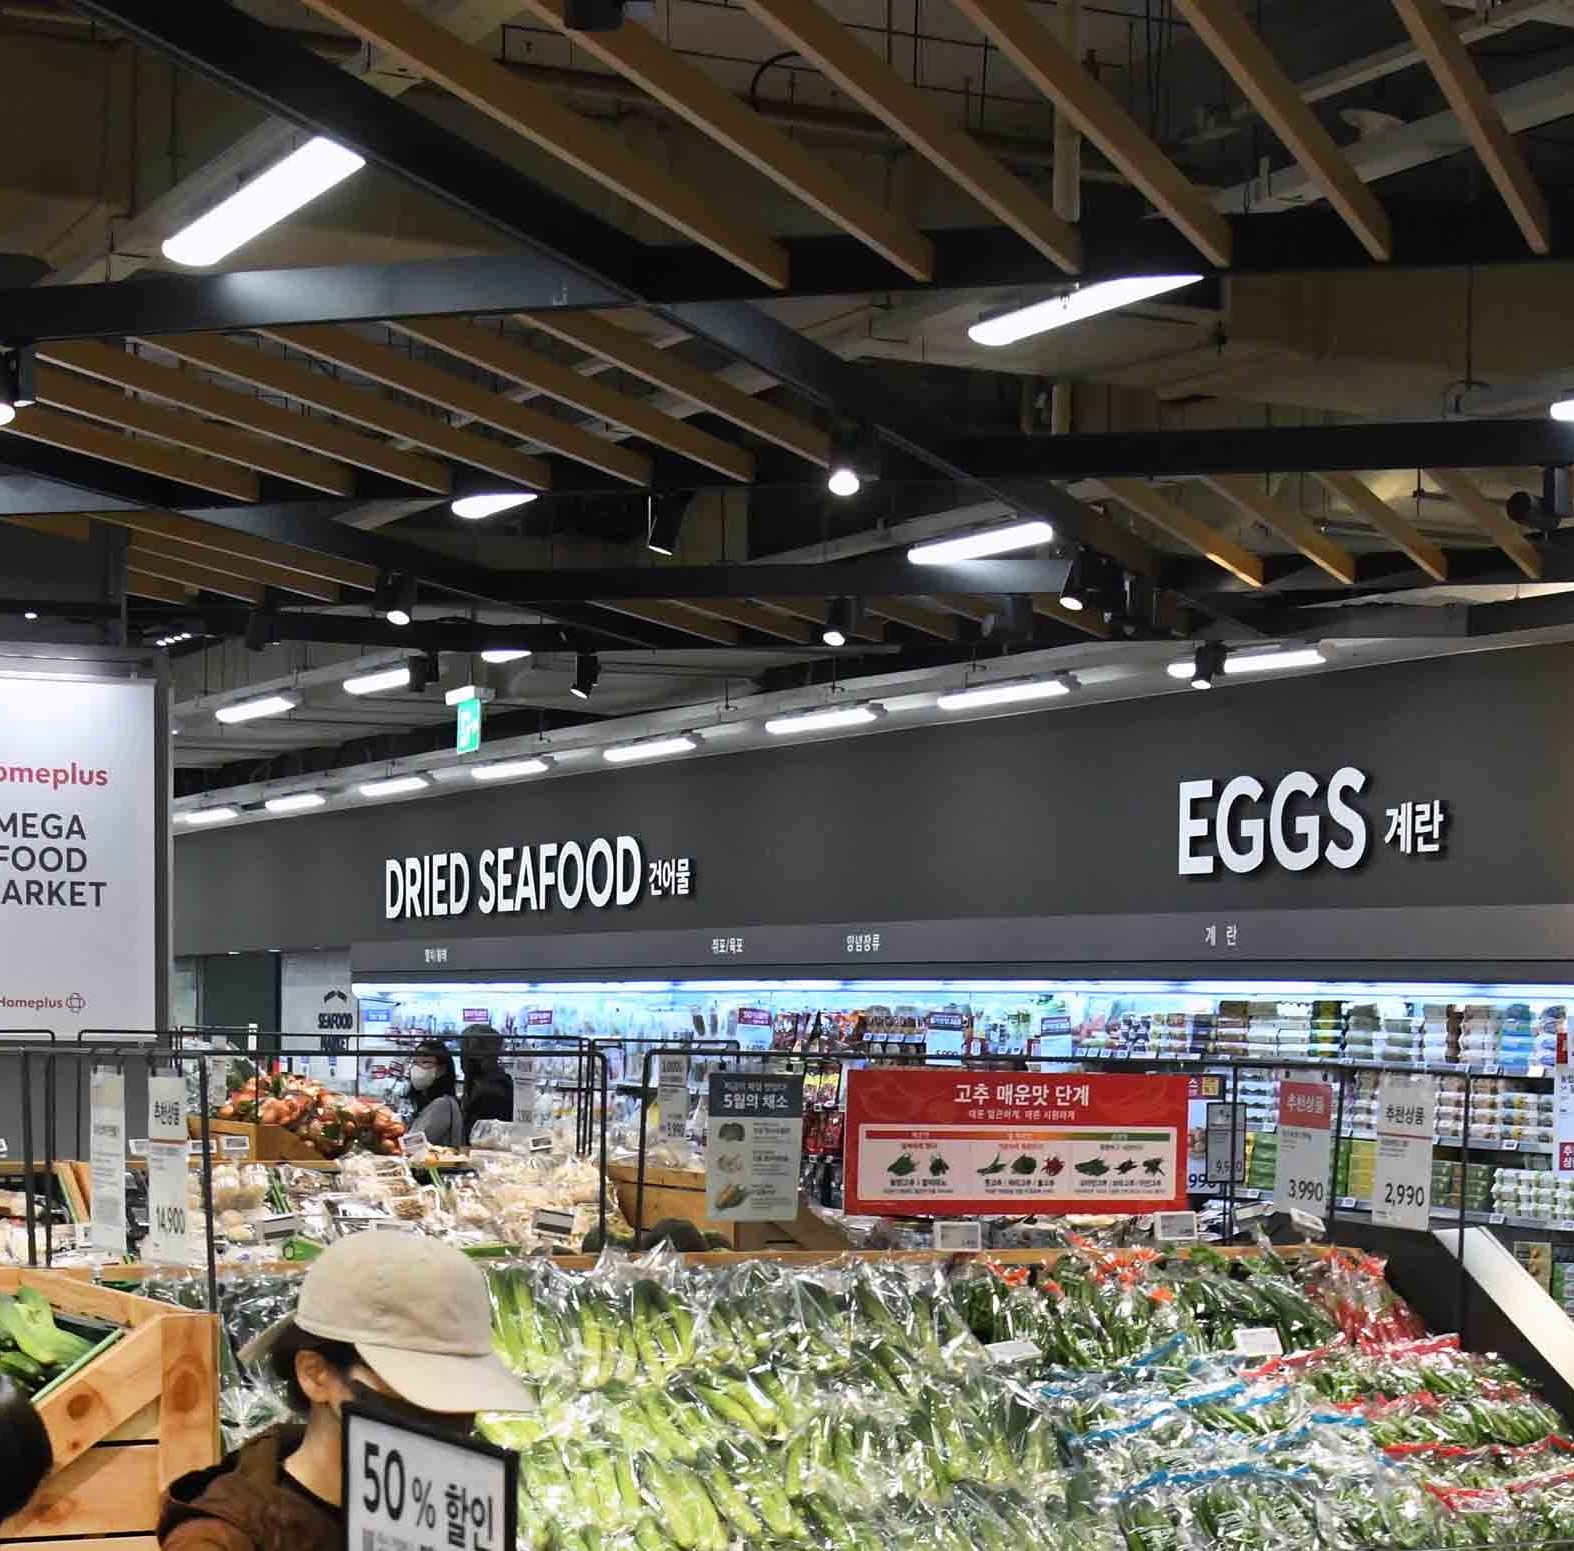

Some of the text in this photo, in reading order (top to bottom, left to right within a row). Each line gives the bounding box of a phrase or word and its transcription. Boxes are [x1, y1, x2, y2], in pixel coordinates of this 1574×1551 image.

[1177, 765, 1367, 877] EGGS
[1383, 799, 1445, 856] 계란
[385, 834, 642, 921] DRIED SEAFOOD
[648, 857, 691, 897] 건어물
[723, 1092, 790, 1110] 5월의 채소
[954, 1083, 1091, 1107] 고추 매운맛 단계
[1384, 1103, 1426, 1126] 추천상품
[1287, 1179, 1324, 1202] 3,990
[1384, 1182, 1426, 1208] 2,990
